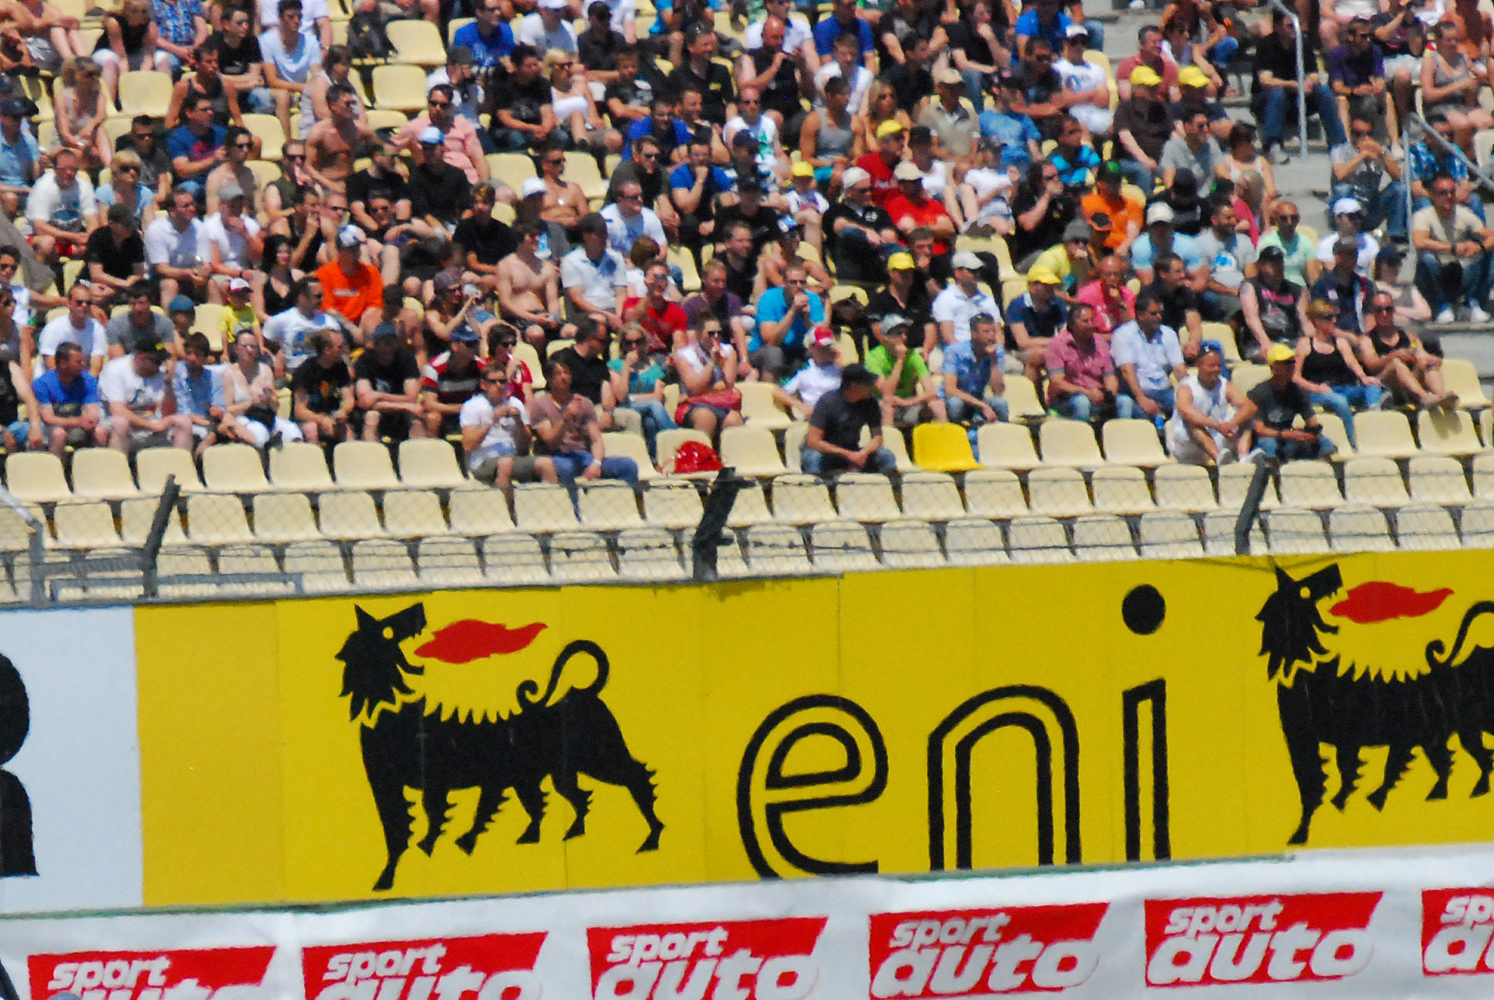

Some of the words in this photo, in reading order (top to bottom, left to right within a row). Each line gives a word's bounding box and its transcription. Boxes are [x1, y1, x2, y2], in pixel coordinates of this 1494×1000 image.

[736, 584, 1172, 880] eni
[889, 912, 1011, 948] sport
[1165, 898, 1284, 937] sport
[324, 944, 447, 981] sport
[606, 925, 729, 965] sport
[1146, 921, 1375, 985] auto
[47, 955, 171, 994] sport
[870, 932, 1100, 999] auto
